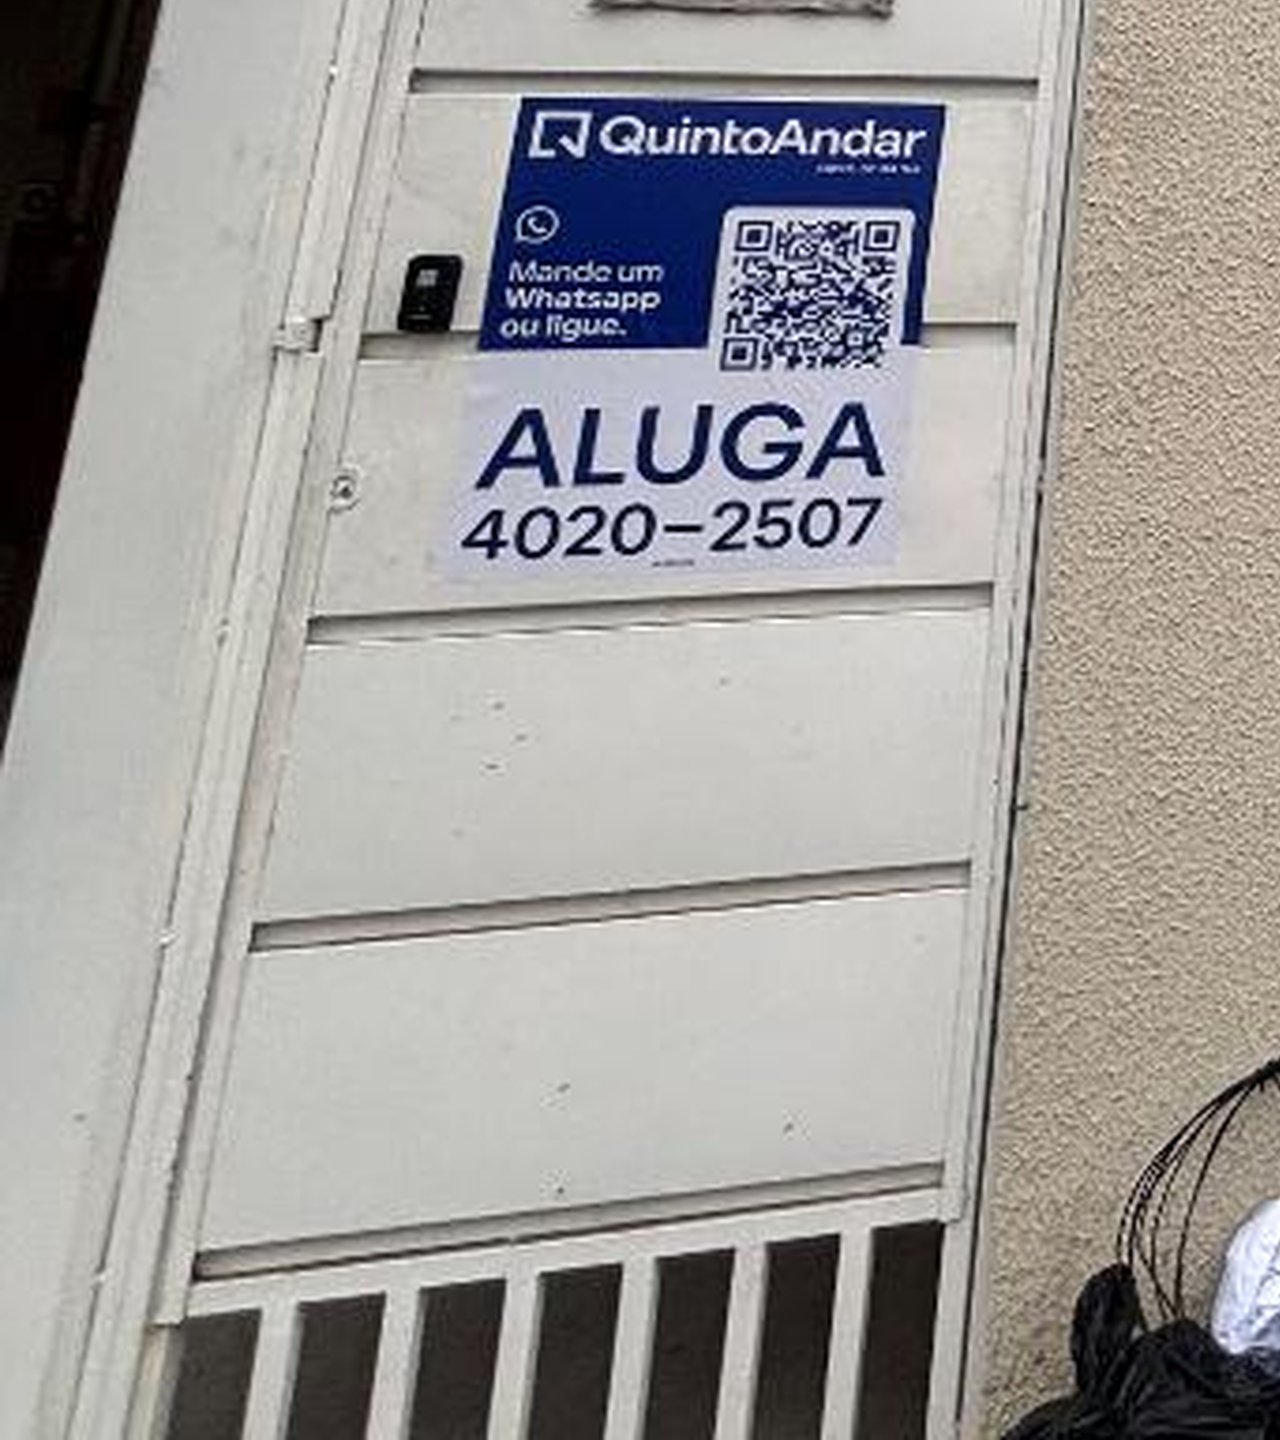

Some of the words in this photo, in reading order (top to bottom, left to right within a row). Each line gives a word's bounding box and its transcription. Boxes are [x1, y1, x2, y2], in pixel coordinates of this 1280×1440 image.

[599, 115, 927, 159] QuintoAndar
[508, 259, 613, 283] Mande
[617, 265, 664, 283] um
[505, 287, 661, 314] Whatsapp
[500, 318, 540, 339] ou
[546, 314, 628, 343] ligue.
[474, 402, 886, 490] ALUGA
[460, 497, 883, 559] 4020-2507
